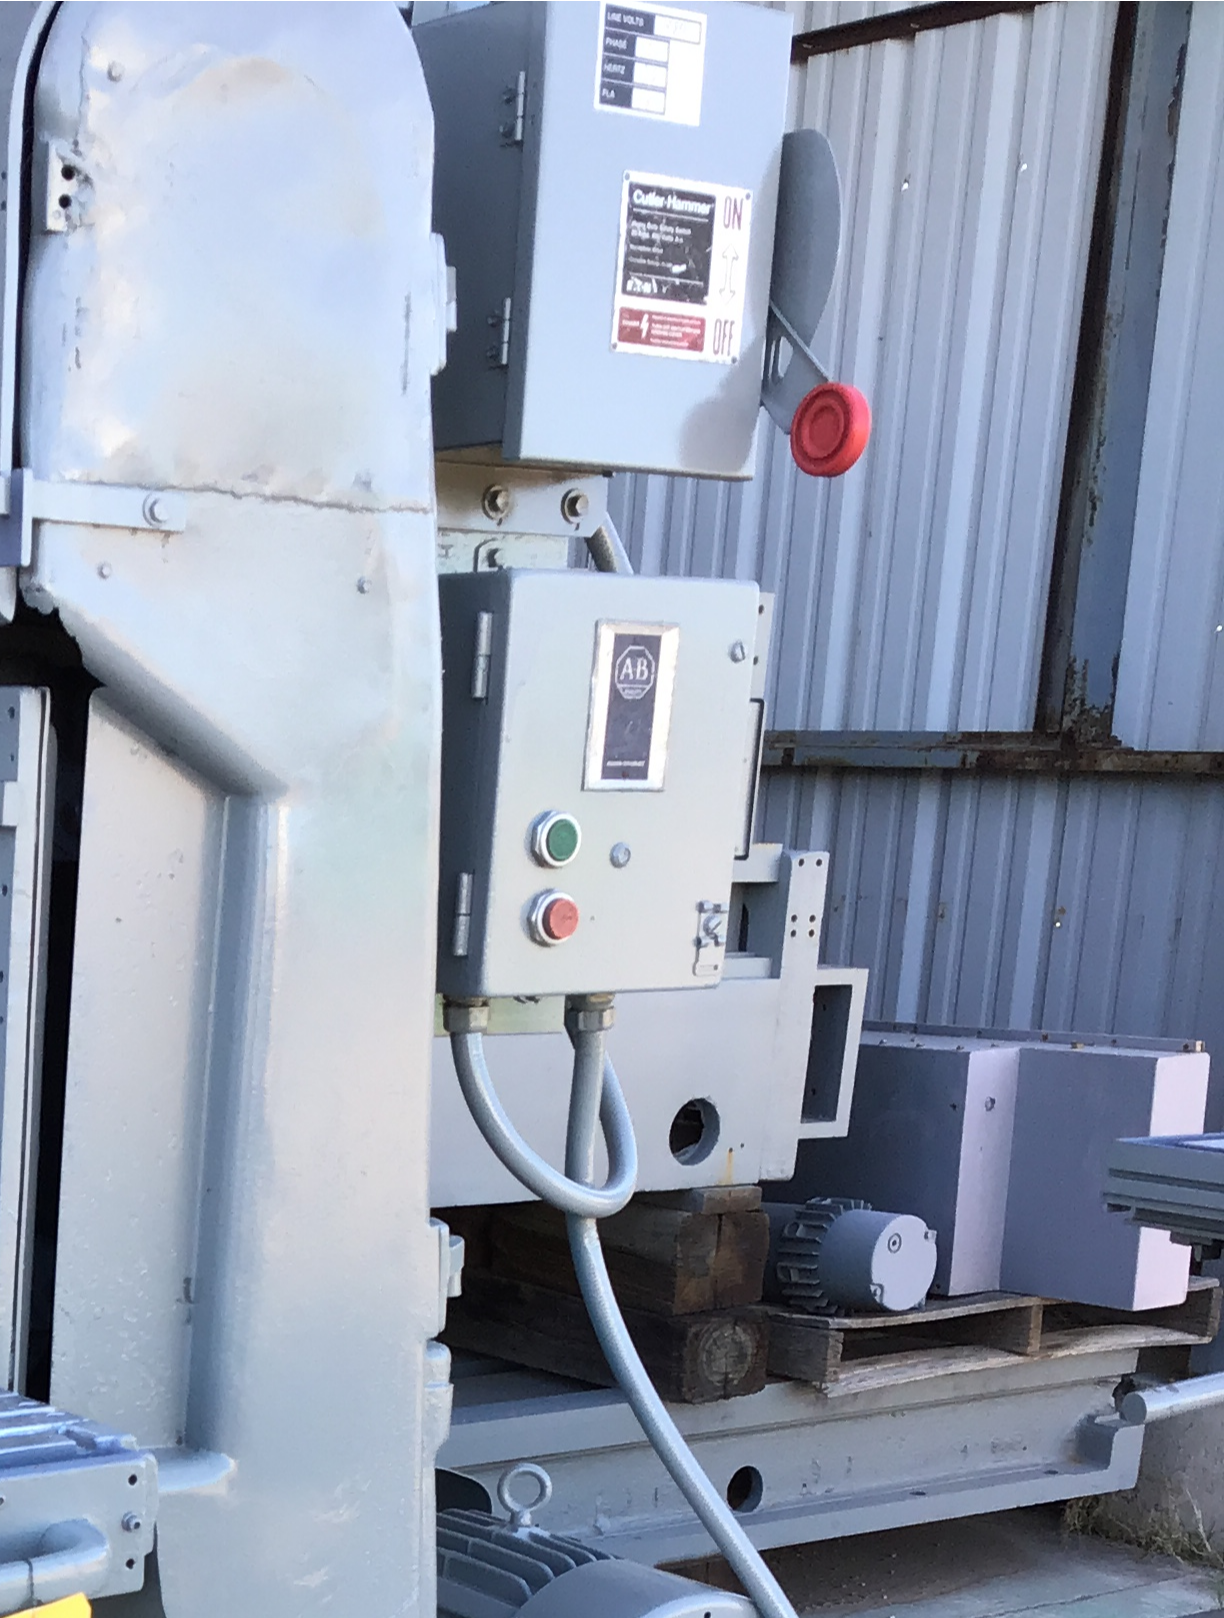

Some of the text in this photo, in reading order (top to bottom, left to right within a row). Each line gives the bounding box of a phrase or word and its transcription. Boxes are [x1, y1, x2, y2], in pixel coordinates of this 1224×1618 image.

[623, 14, 645, 27] VOLTS
[603, 62, 626, 75] HERTZ
[723, 195, 743, 231] ON
[713, 318, 735, 357] OFF
